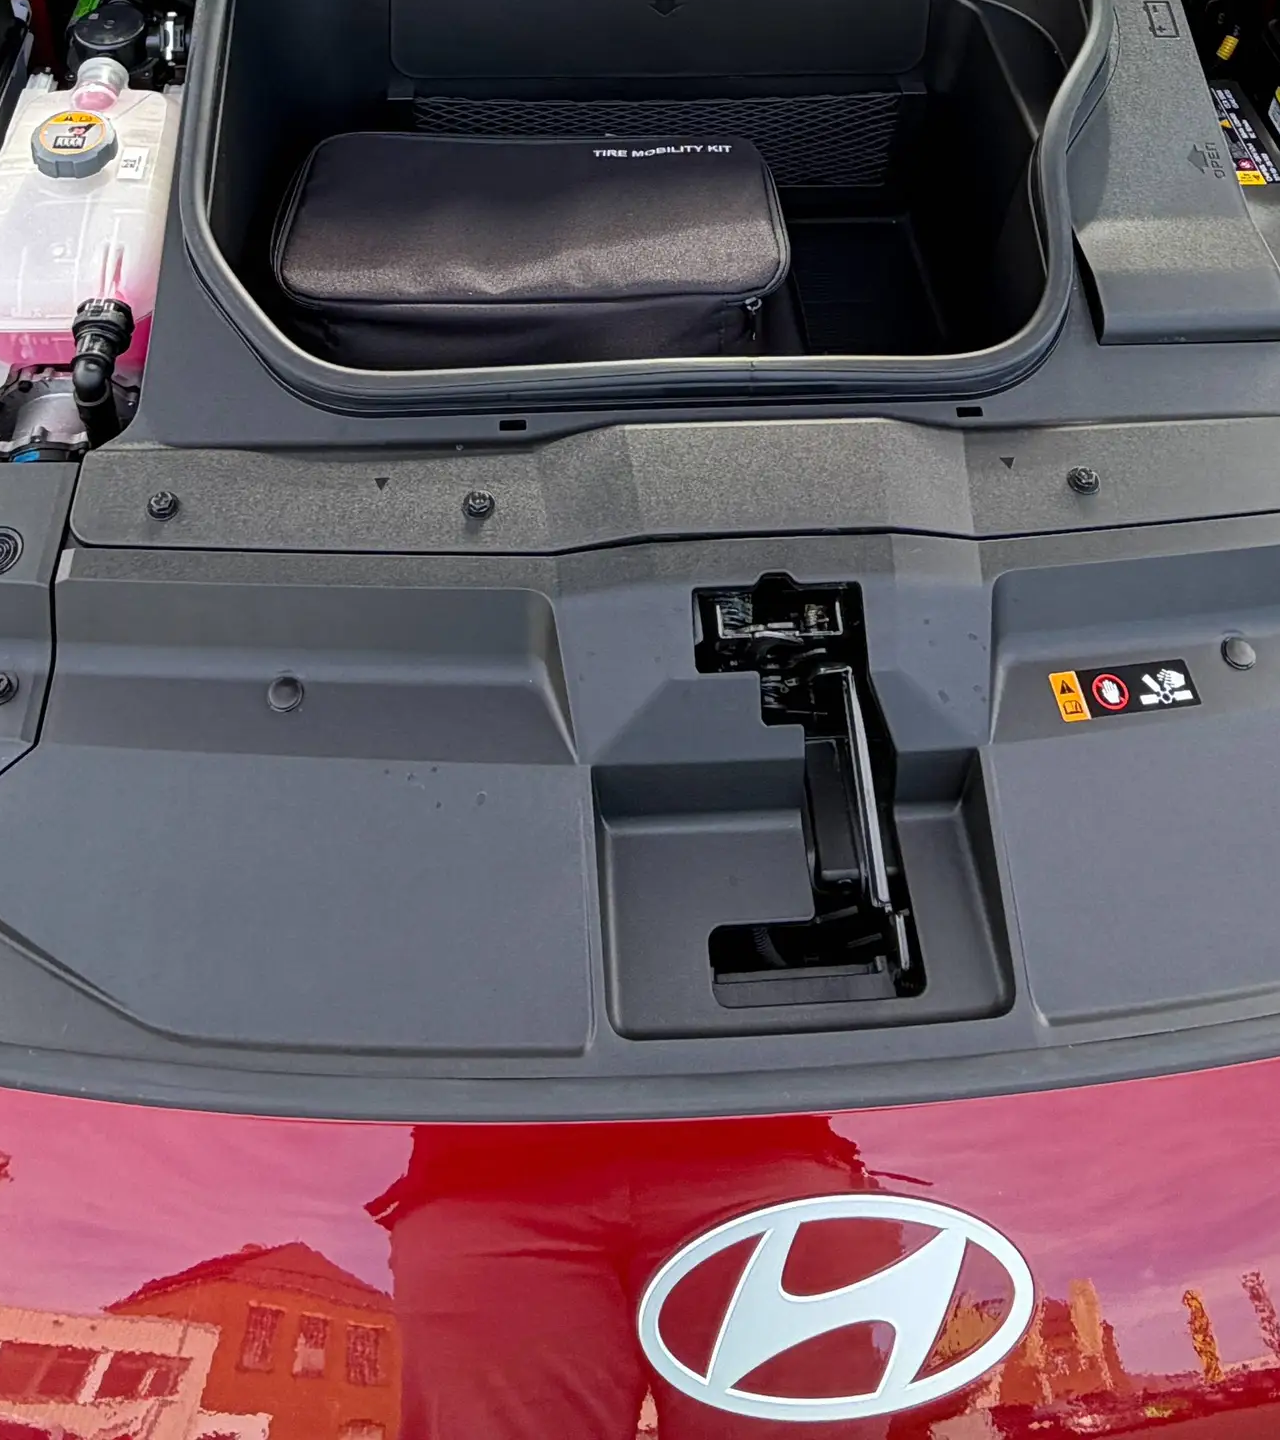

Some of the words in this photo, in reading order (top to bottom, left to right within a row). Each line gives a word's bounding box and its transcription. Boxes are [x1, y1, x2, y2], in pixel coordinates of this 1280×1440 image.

[592, 149, 628, 158] TIRE
[631, 145, 703, 158] MOBILITY
[707, 145, 732, 153] KIT
[1205, 142, 1226, 179] OPEN
